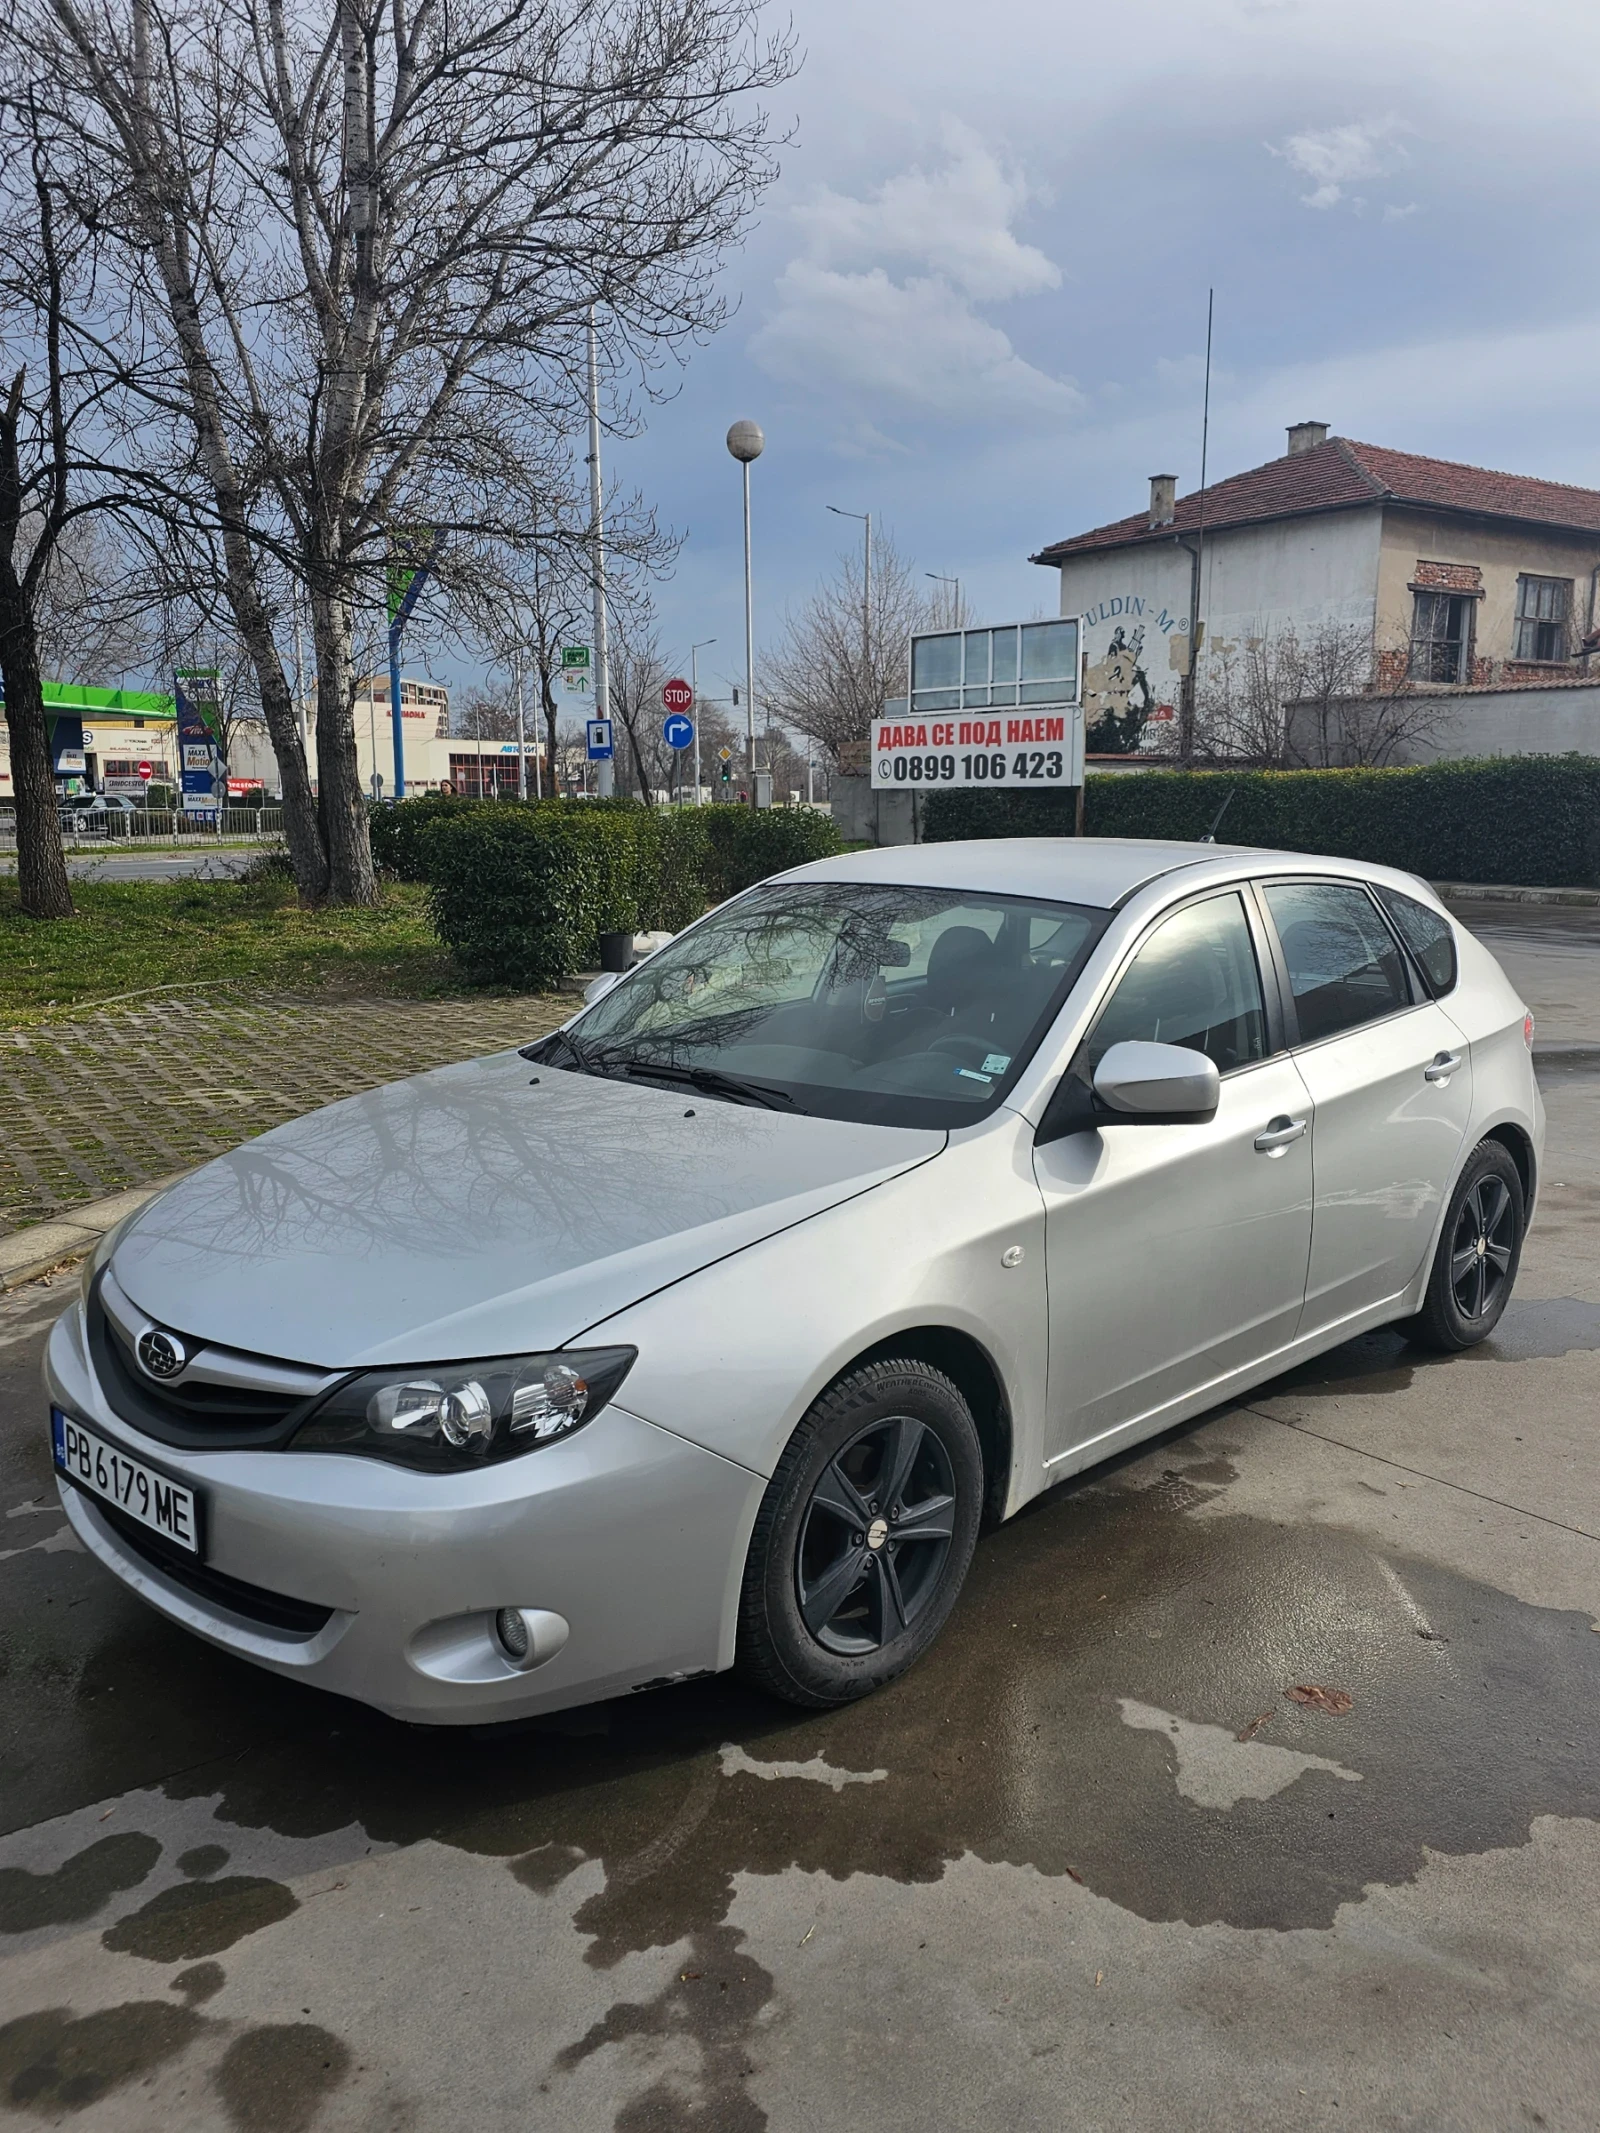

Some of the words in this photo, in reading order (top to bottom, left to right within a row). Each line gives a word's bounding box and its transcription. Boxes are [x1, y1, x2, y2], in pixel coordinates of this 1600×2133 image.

[665, 689, 691, 703] STOP
[877, 725, 927, 751] ДАВА
[931, 723, 954, 746] СЕ
[959, 720, 1001, 747] ПОД
[1007, 717, 1064, 743] НАЕМ
[187, 749, 206, 757] MAXX
[186, 756, 210, 766] Motio
[893, 755, 955, 781] 0899
[960, 753, 1006, 780] 106
[1012, 751, 1063, 779] 423
[226, 780, 262, 789] irestone
[96, 1446, 149, 1516] 6179
